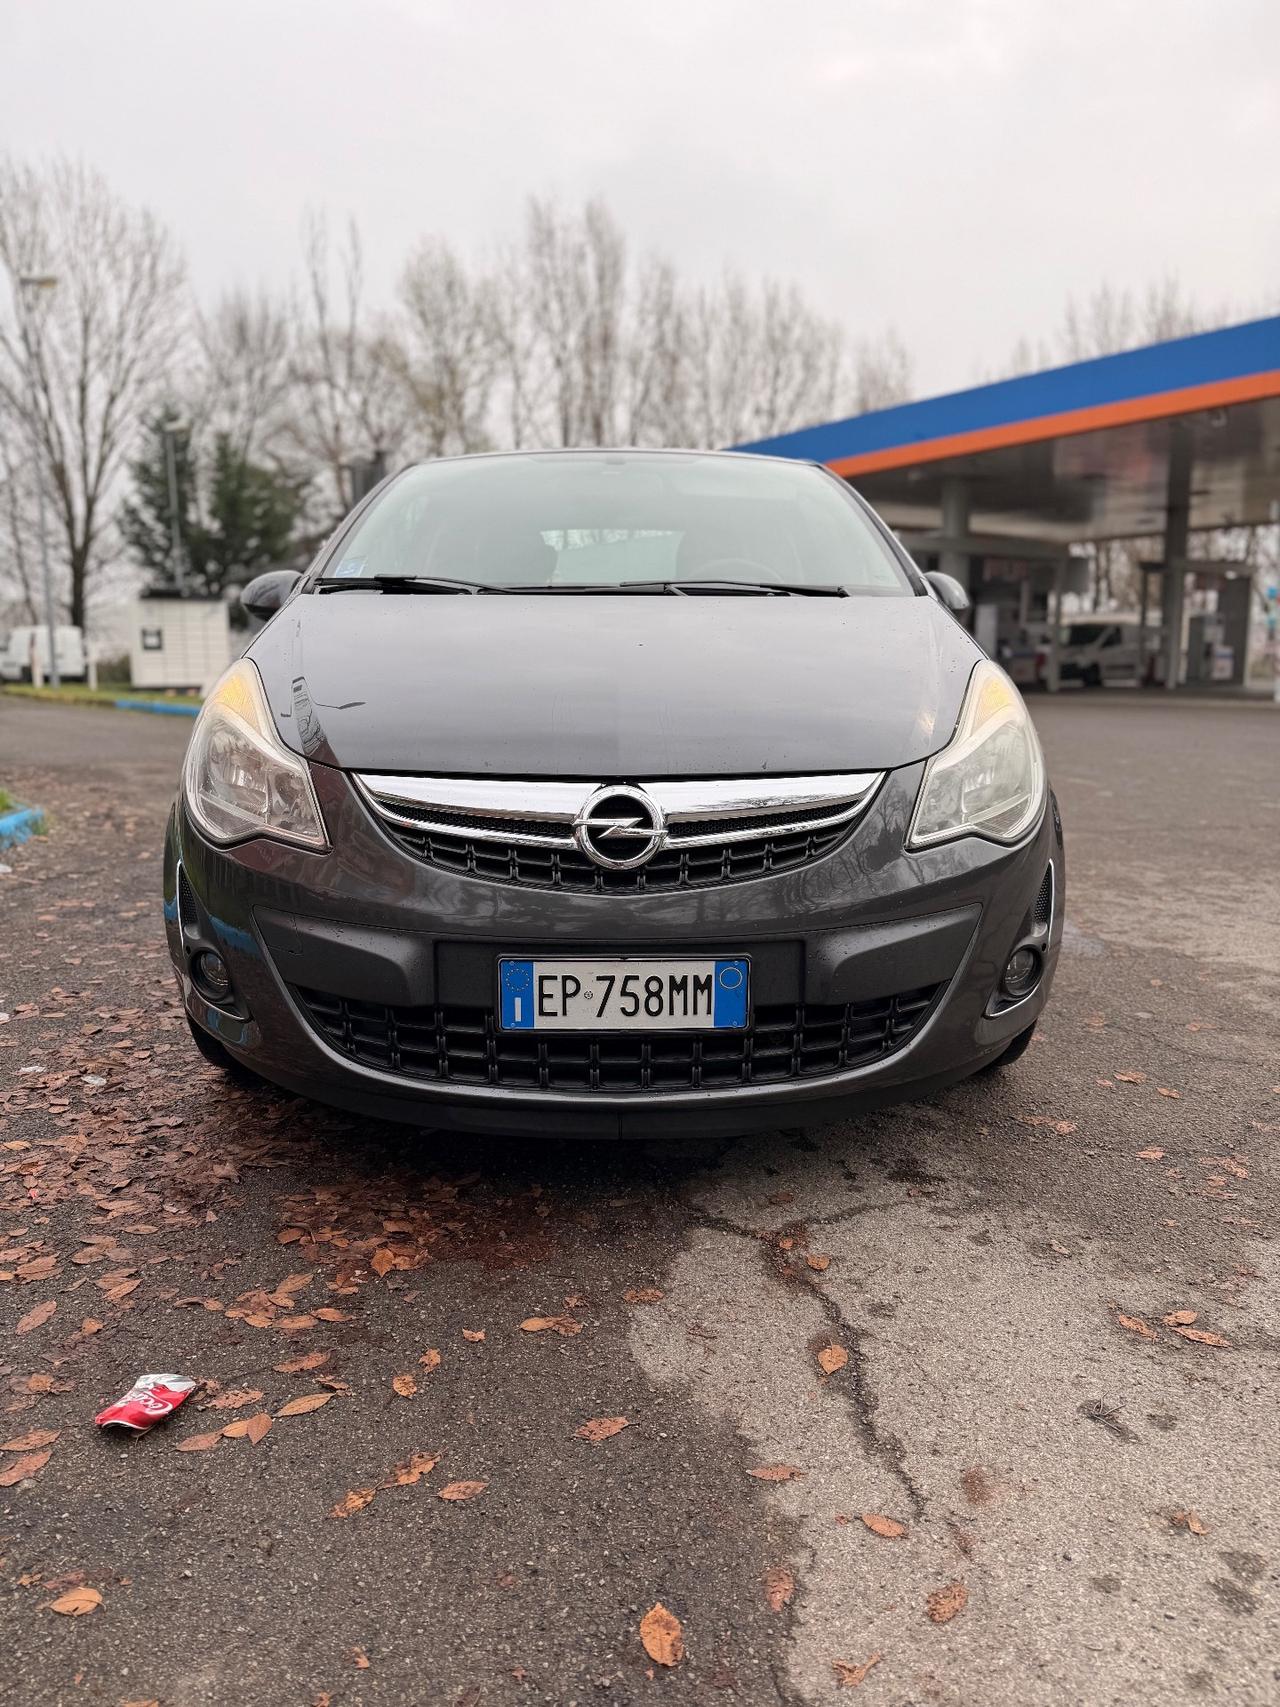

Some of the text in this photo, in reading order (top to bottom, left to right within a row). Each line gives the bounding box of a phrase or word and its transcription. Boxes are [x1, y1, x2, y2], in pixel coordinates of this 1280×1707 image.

[514, 997, 522, 1022] I
[538, 974, 713, 1017] EP 758MM
